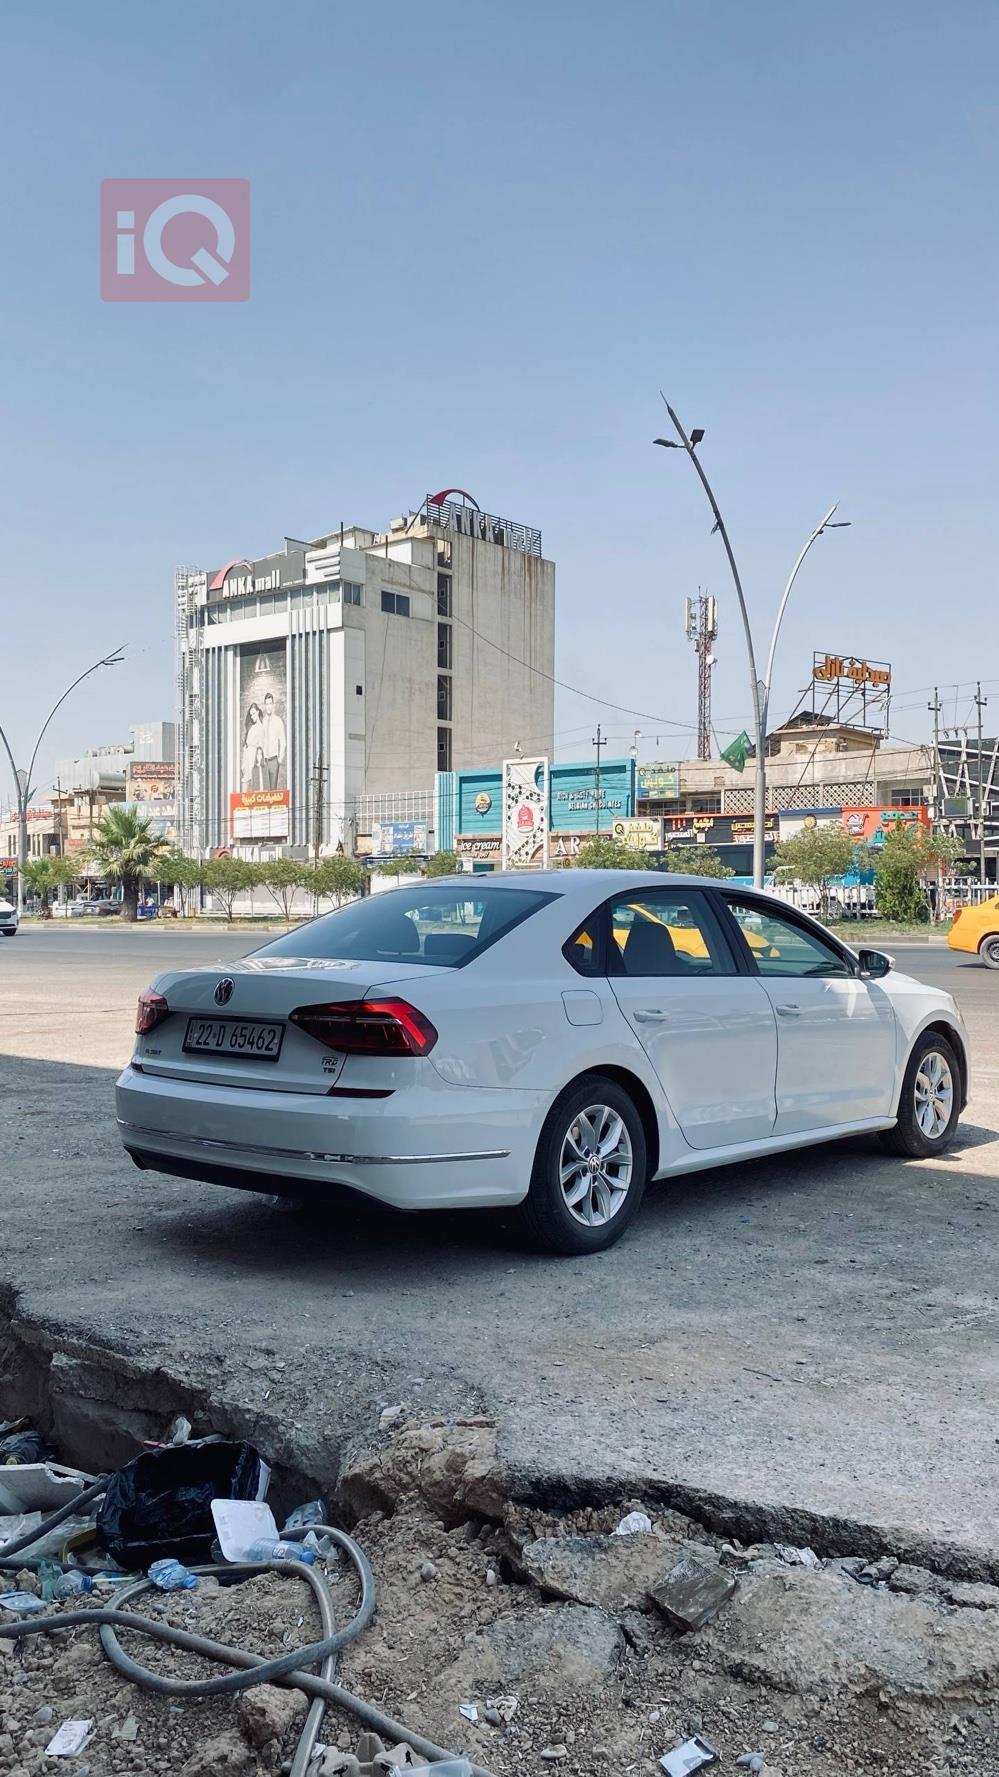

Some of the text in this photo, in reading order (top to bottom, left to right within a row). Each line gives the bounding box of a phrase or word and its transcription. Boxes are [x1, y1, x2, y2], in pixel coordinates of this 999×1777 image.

[448, 502, 495, 543] ANKA
[222, 569, 280, 599] ANKA mall
[461, 840, 501, 851] ice cream
[230, 1026, 277, 1051] 65462
